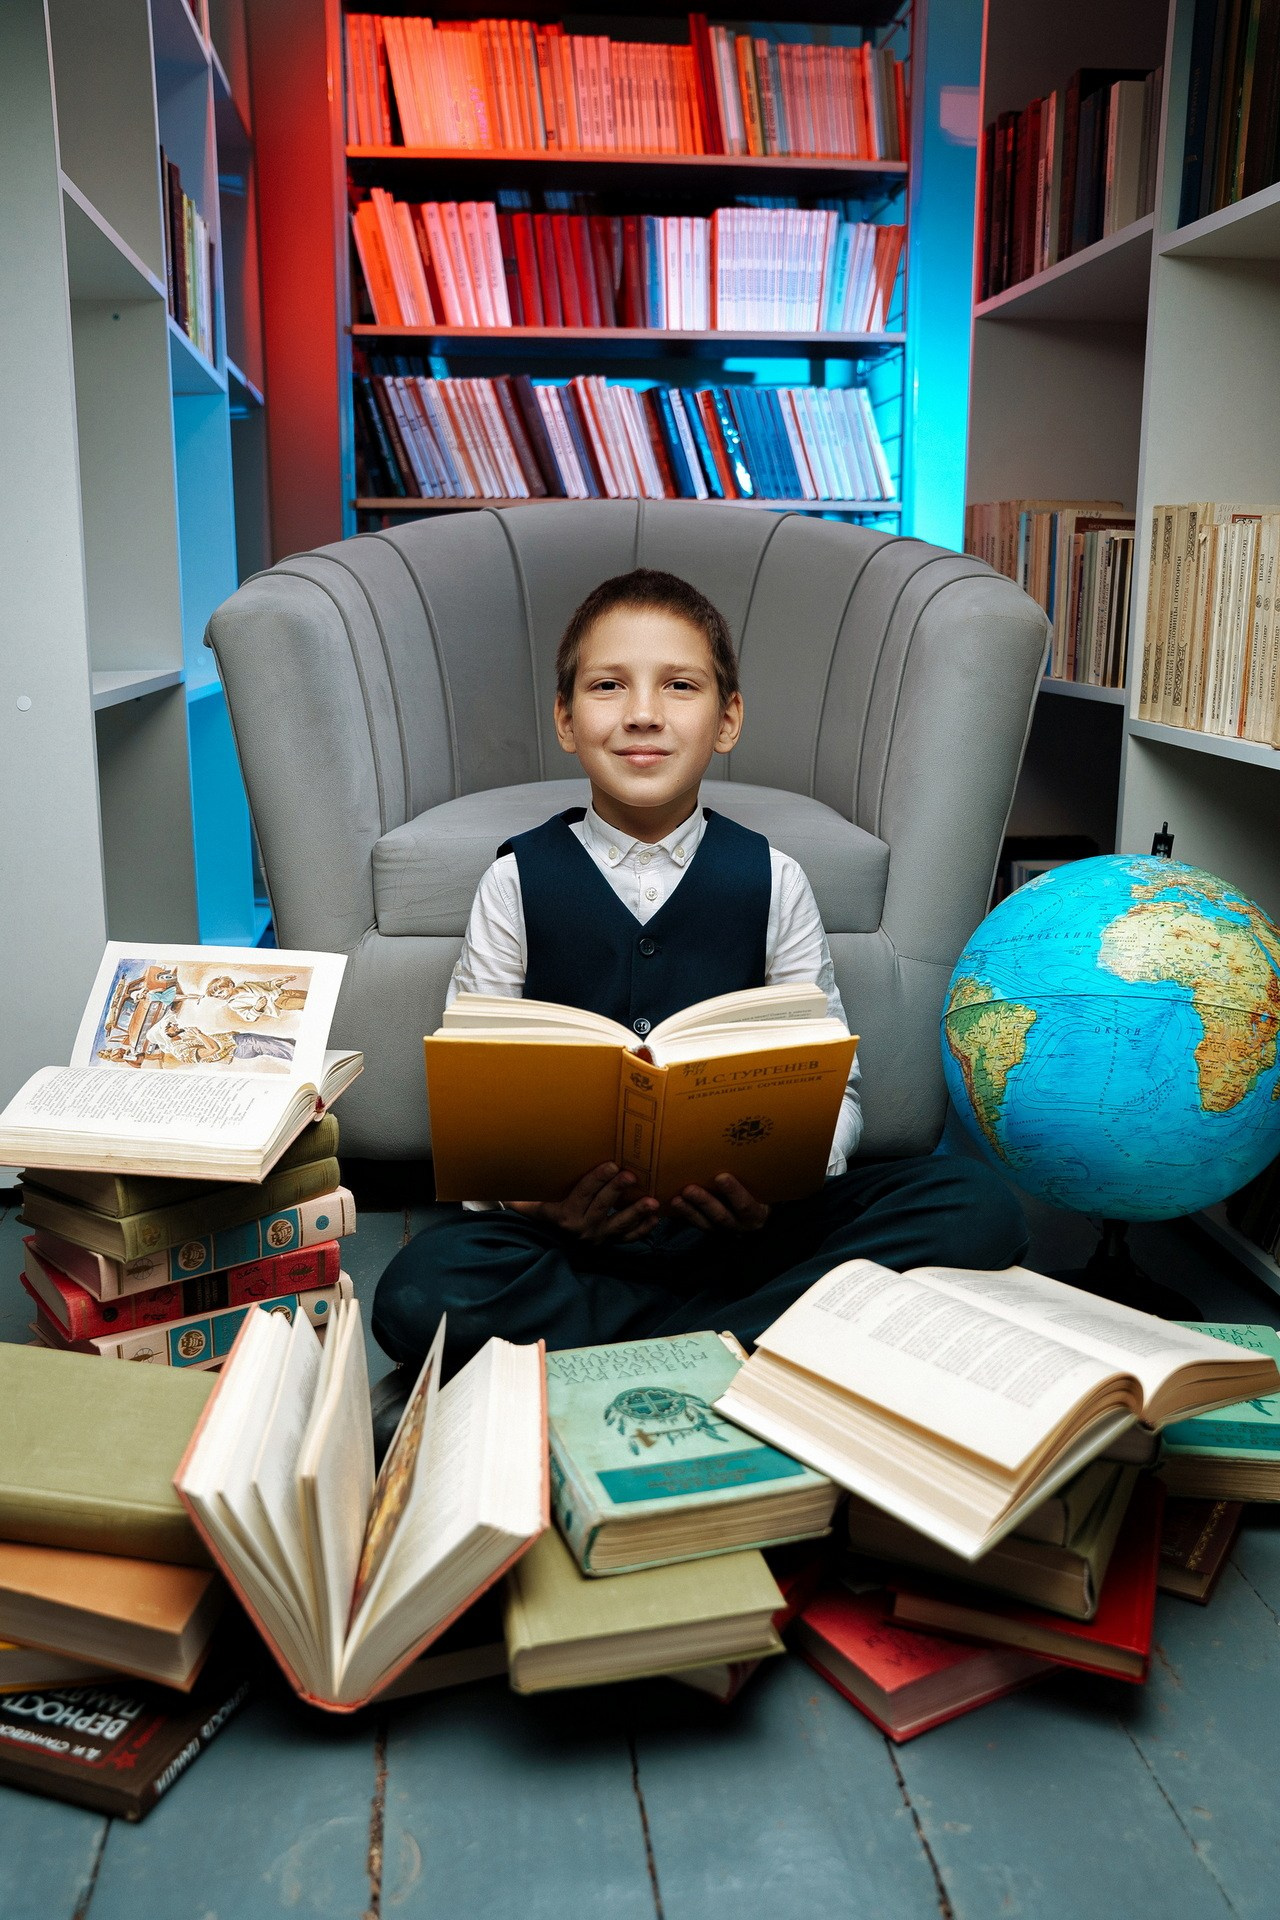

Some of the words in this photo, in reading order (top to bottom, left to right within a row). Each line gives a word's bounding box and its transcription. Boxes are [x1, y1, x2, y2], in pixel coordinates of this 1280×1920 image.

[1094, 1026, 1141, 1036] ОКЕАН
[729, 1060, 819, 1081] ТУРГЕНЕВ
[687, 1085, 753, 1100] ИЗБРАННЫЕ
[756, 1075, 823, 1089] СОЧИНЕНИЯ
[552, 1340, 699, 1364] ИБЛИОТЕКА
